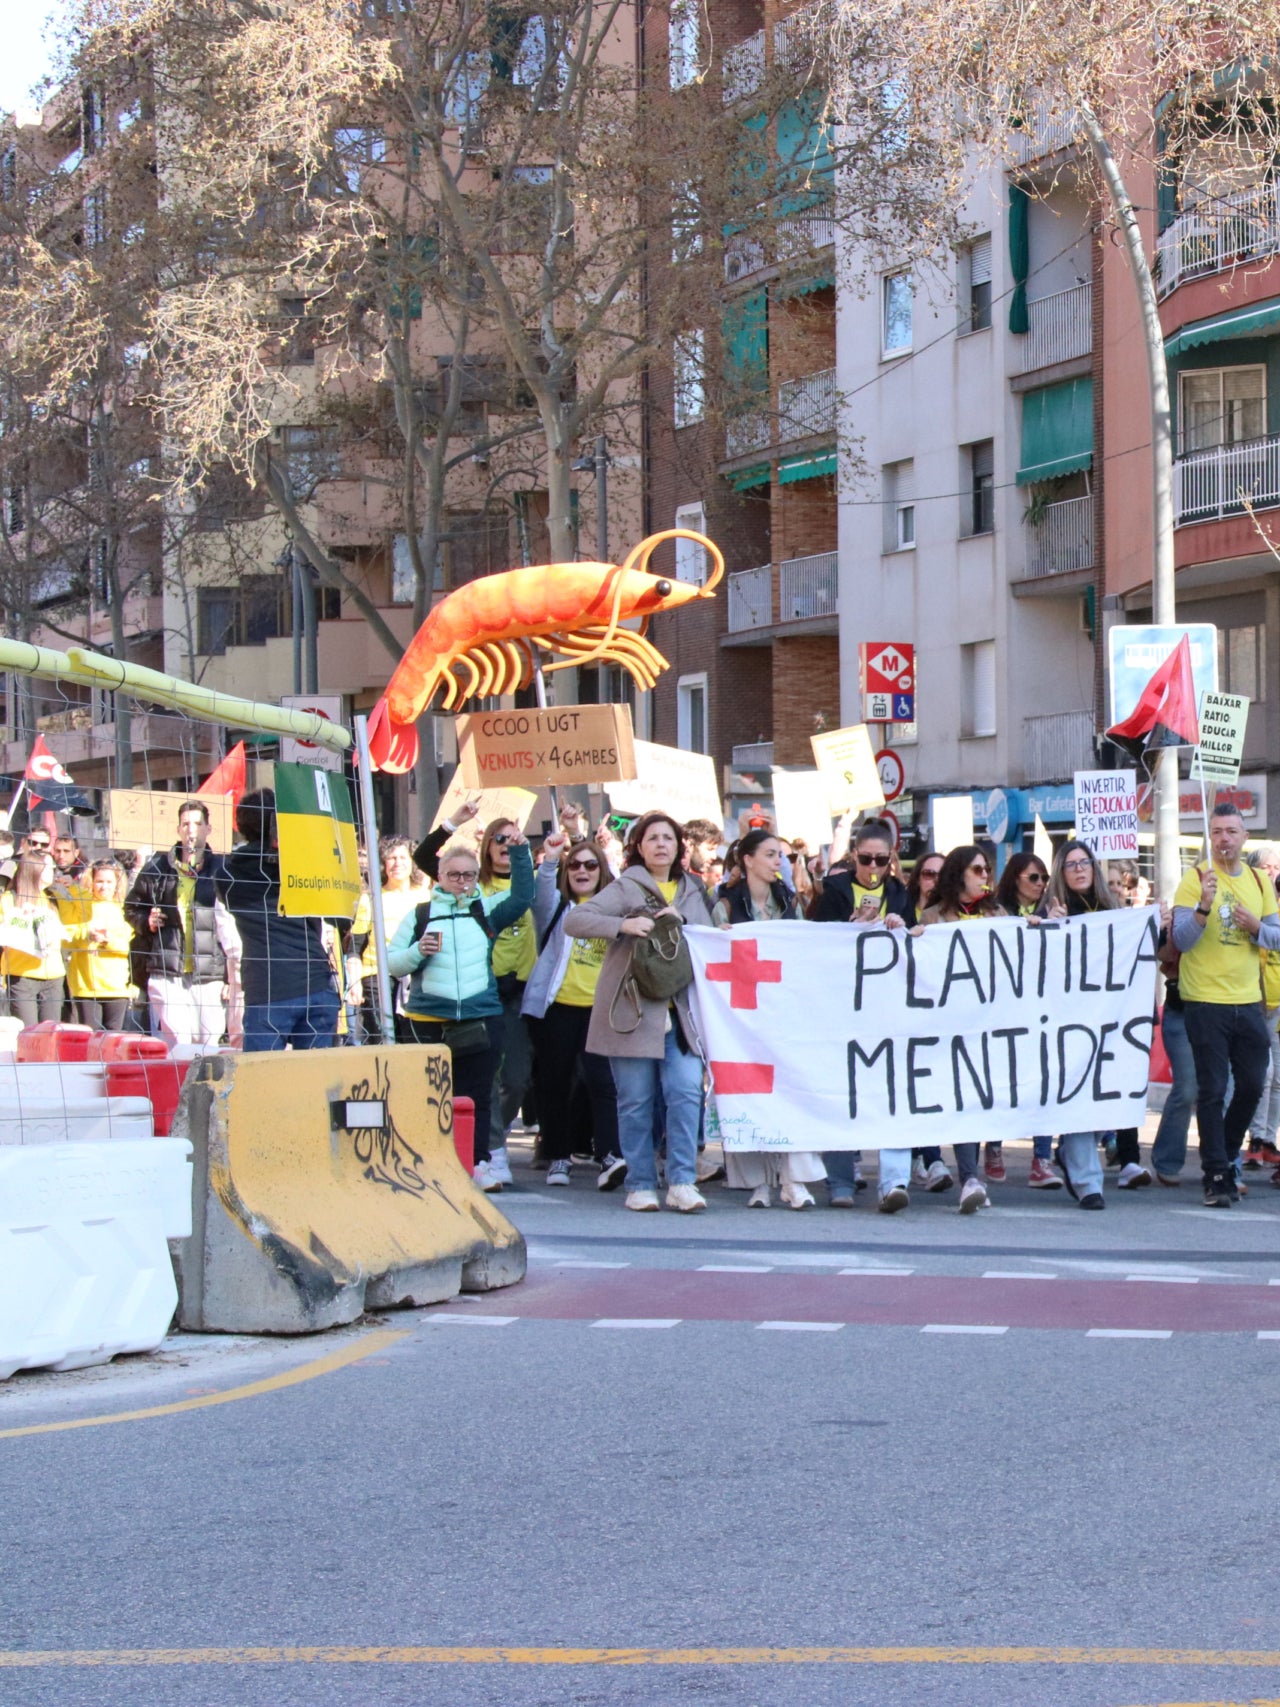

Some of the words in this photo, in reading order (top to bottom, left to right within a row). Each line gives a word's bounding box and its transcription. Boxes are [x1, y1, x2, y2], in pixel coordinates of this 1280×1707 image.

[882, 655, 899, 671] M
[1207, 695, 1242, 709] BAIXAR
[482, 716, 529, 737] CCOO
[536, 715, 541, 733] I
[547, 712, 580, 733] UGT
[1202, 725, 1237, 738] EDUCAR
[1199, 739, 1233, 753] MILLOR
[477, 751, 534, 771] VENUTS
[549, 745, 561, 769] 4
[563, 748, 618, 768] GAMBES
[1081, 776, 1126, 795] INVERTIR
[1077, 797, 1091, 814] EN
[1092, 791, 1137, 814] EDUCACIÓ
[1098, 813, 1138, 831] INVERTIR
[1102, 833, 1137, 852] FUTUR
[287, 874, 330, 892] Disculpin
[719, 1112, 755, 1125] scola
